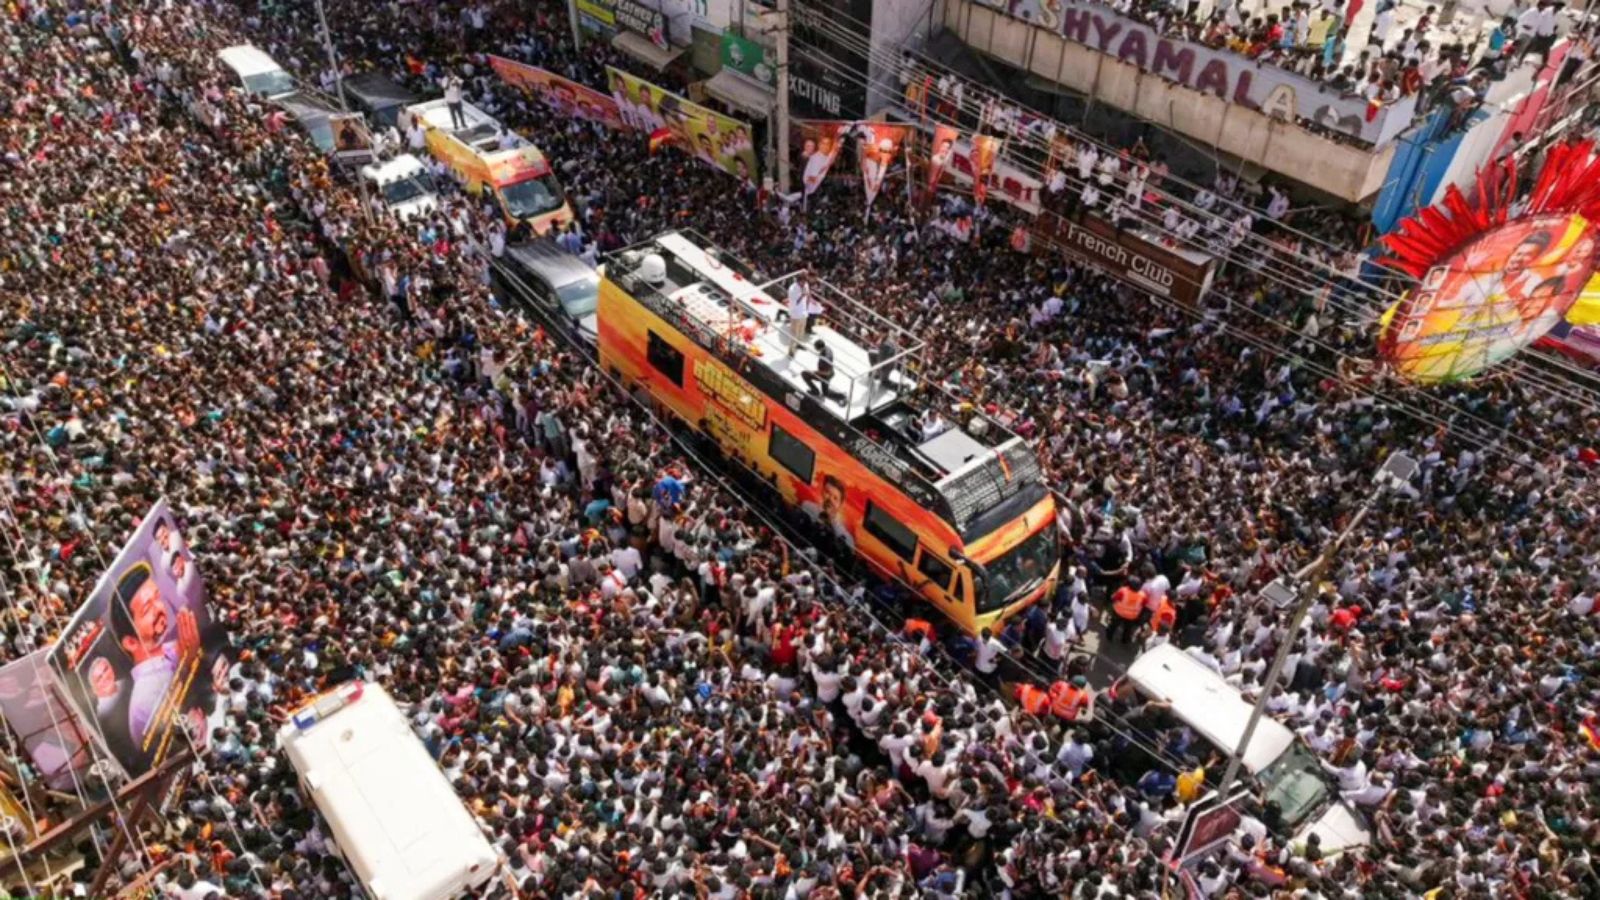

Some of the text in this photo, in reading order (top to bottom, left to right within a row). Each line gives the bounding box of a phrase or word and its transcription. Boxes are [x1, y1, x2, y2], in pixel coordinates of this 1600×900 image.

[1038, 0, 1298, 123] SHYAMALA
[788, 73, 841, 116] XCITING
[1067, 224, 1128, 266] French
[1130, 254, 1174, 288] Club
